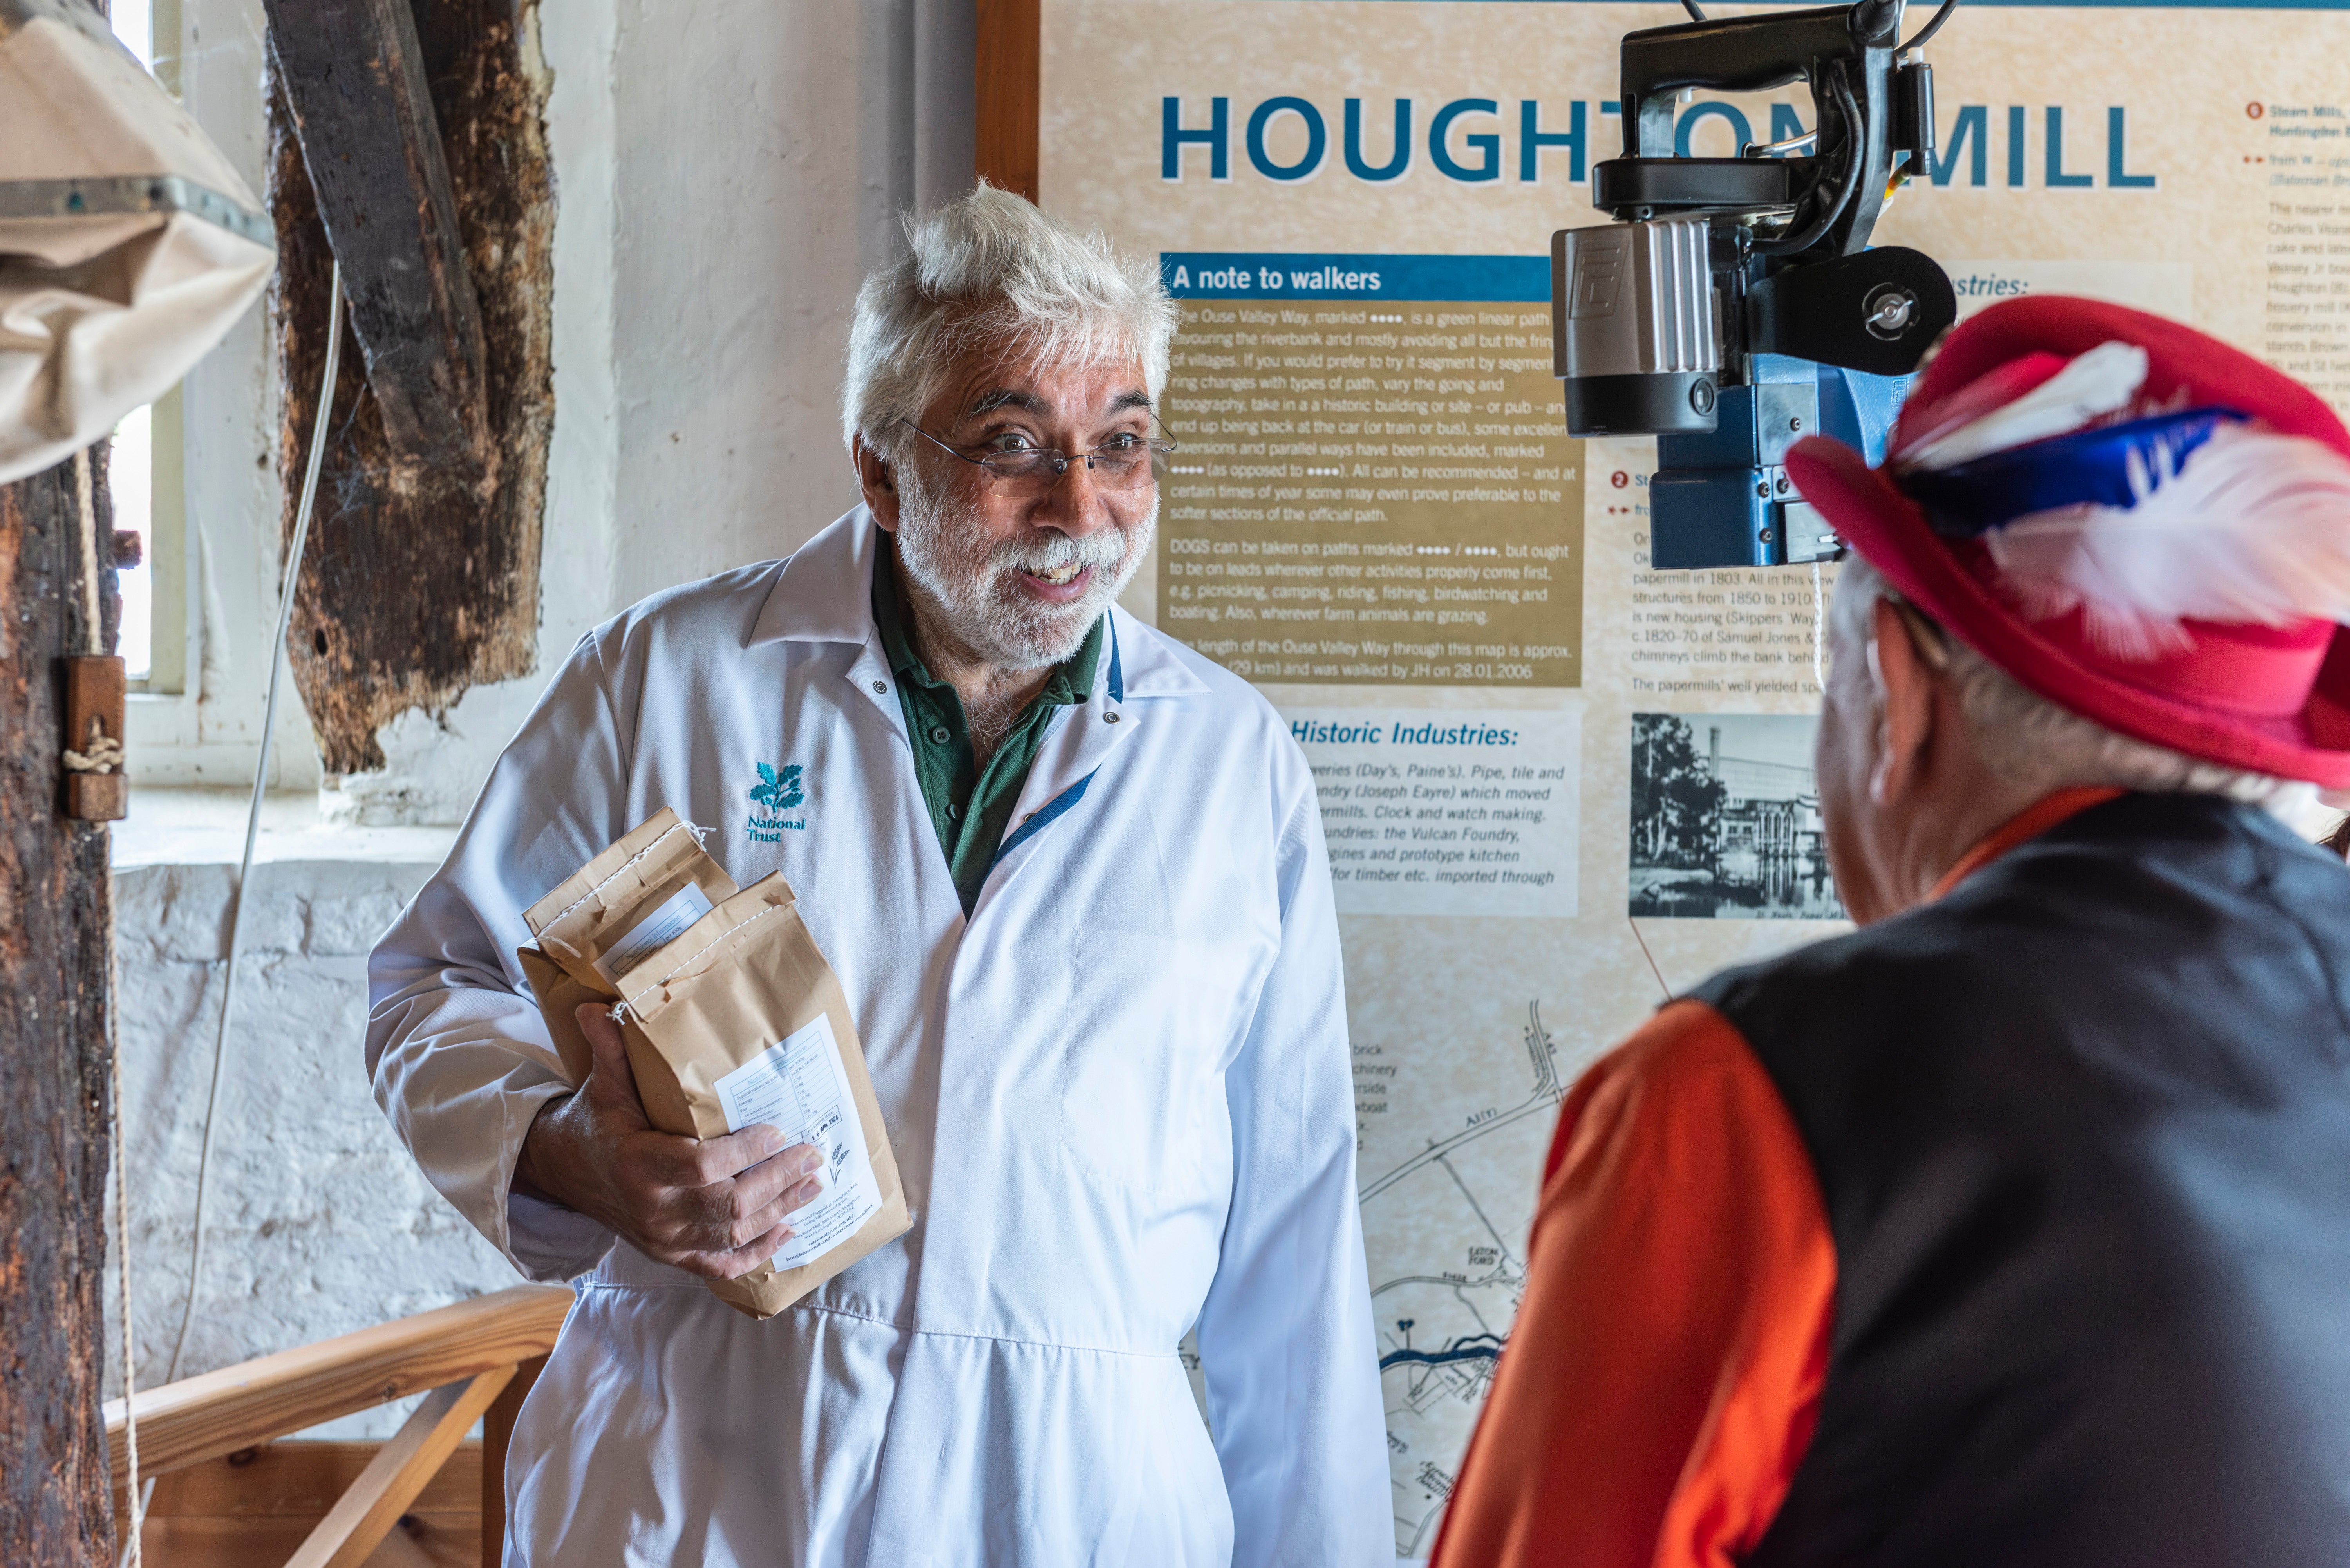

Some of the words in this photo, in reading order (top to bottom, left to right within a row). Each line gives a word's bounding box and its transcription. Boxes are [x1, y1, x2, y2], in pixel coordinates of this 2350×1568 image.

[1173, 266, 1191, 289] A
[1199, 266, 1251, 289] note
[1259, 266, 1283, 289] to
[1291, 267, 1381, 290] walkers
[1201, 308, 1236, 323] Ouse
[1239, 309, 1278, 326] Valley
[1315, 310, 1366, 324] marked
[1410, 312, 1423, 325] is
[1424, 314, 1434, 325] a
[1437, 313, 1475, 328] green
[1479, 311, 1515, 326] linear
[1519, 313, 1549, 328] path
[1169, 562, 1183, 575] to
[1186, 562, 1204, 576] be
[1205, 564, 1224, 576] on
[1226, 562, 1262, 576] leads
[1264, 562, 1324, 577] wherever
[1327, 564, 1363, 578] other
[1365, 564, 1422, 578] activities
[1426, 565, 1480, 581] properly
[1482, 567, 1520, 579] come
[1633, 571, 1690, 585] papermill
[1694, 574, 1705, 583] in
[1748, 573, 1763, 584] All
[1768, 575, 1779, 585] in
[1782, 573, 1804, 586] this
[1632, 591, 1694, 603] structures
[1697, 591, 1725, 604] from
[1731, 591, 1761, 604] 1850
[1764, 593, 1776, 605] to
[1632, 612, 1642, 622] is
[1646, 613, 1671, 623] new
[1674, 611, 1723, 626] housing
[1726, 611, 1783, 625] (Skippers
[1701, 629, 1713, 643] of
[1717, 630, 1763, 644] Samuel
[1766, 631, 1801, 645] Jones
[1197, 638, 1238, 656] length
[1242, 639, 1255, 653] of
[1258, 640, 1280, 653] the
[1282, 638, 1317, 654] Ouse
[1320, 640, 1359, 657] Valley
[1361, 640, 1390, 657] Way
[1393, 642, 1444, 658] through
[1448, 642, 1472, 656] this
[1475, 644, 1506, 659] map
[1509, 645, 1520, 657] is
[1523, 645, 1571, 659] approx.
[1631, 649, 1689, 664] chimneys
[1693, 650, 1727, 662] climb
[1730, 651, 1750, 663] the
[1754, 651, 1783, 664] bank
[1283, 662, 1310, 675] and
[1312, 664, 1339, 676] was
[1341, 663, 1388, 676] walked
[1392, 664, 1408, 679] by
[1411, 663, 1430, 677] JH
[1433, 666, 1450, 677] on
[1454, 663, 1532, 679] 28.01.2006
[1633, 677, 1654, 690] The
[1728, 679, 1751, 692] well
[1755, 680, 1798, 694] yielded
[1291, 720, 1381, 744] Historic
[1392, 722, 1518, 746] Industries:
[1471, 764, 1506, 780] Pipe,
[1511, 766, 1534, 779] tile
[1538, 766, 1565, 780] and
[1355, 784, 1408, 800] (Joseph
[1412, 784, 1456, 801] Eayre)
[1460, 786, 1501, 800] which
[1505, 787, 1551, 800] moved
[748, 815, 806, 830] National
[1374, 804, 1412, 819] Clock
[1416, 806, 1443, 820] and
[1447, 807, 1487, 820] watch
[1492, 808, 1546, 824] making.
[747, 829, 781, 842] Trust
[1384, 827, 1407, 840] the
[1412, 827, 1457, 840] Vulcan
[1462, 827, 1519, 844] Foundry,
[1369, 847, 1396, 861] and
[1399, 848, 1465, 864] prototype
[1469, 849, 1520, 862] kitchen
[1355, 868, 1401, 882] timber
[1435, 870, 1498, 884] imported
[1502, 870, 1555, 886] through
[832, 1189, 851, 1204] Houghton
[804, 1218, 816, 1227] using
[822, 1203, 837, 1216] sourced
[838, 1197, 848, 1207] grain
[786, 1204, 873, 1261] houghton-mill-and-waterclose-meadows
[808, 1214, 853, 1246] nationaltrust.org.uk/
